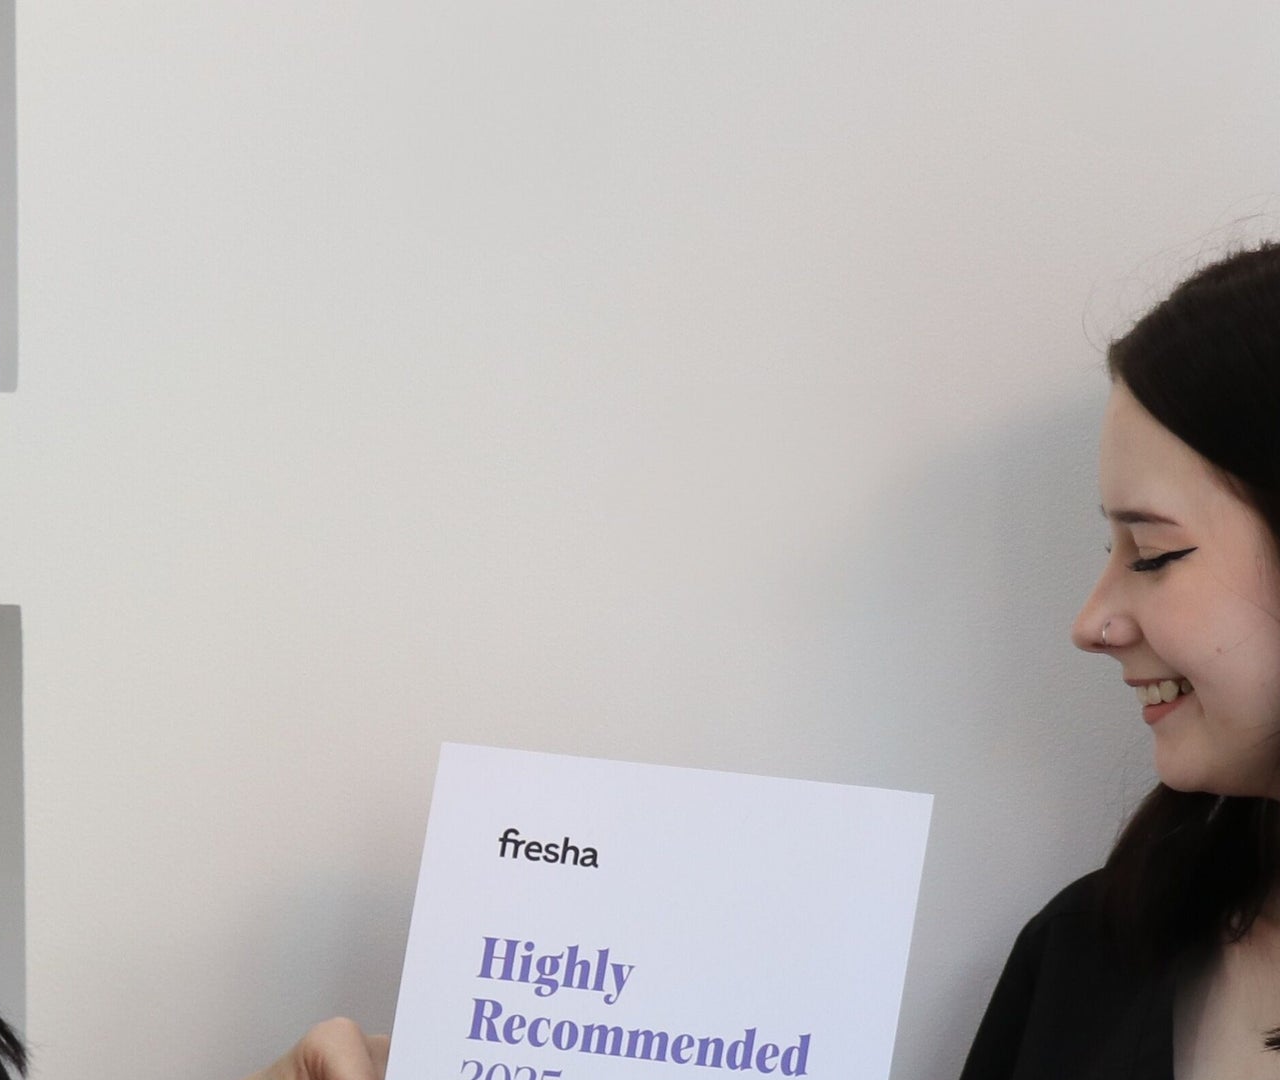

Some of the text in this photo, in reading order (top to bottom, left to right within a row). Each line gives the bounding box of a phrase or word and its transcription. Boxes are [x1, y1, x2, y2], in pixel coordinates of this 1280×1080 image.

[498, 828, 599, 868] fresha
[476, 936, 636, 1005] Highly
[466, 998, 812, 1077] Recommended
